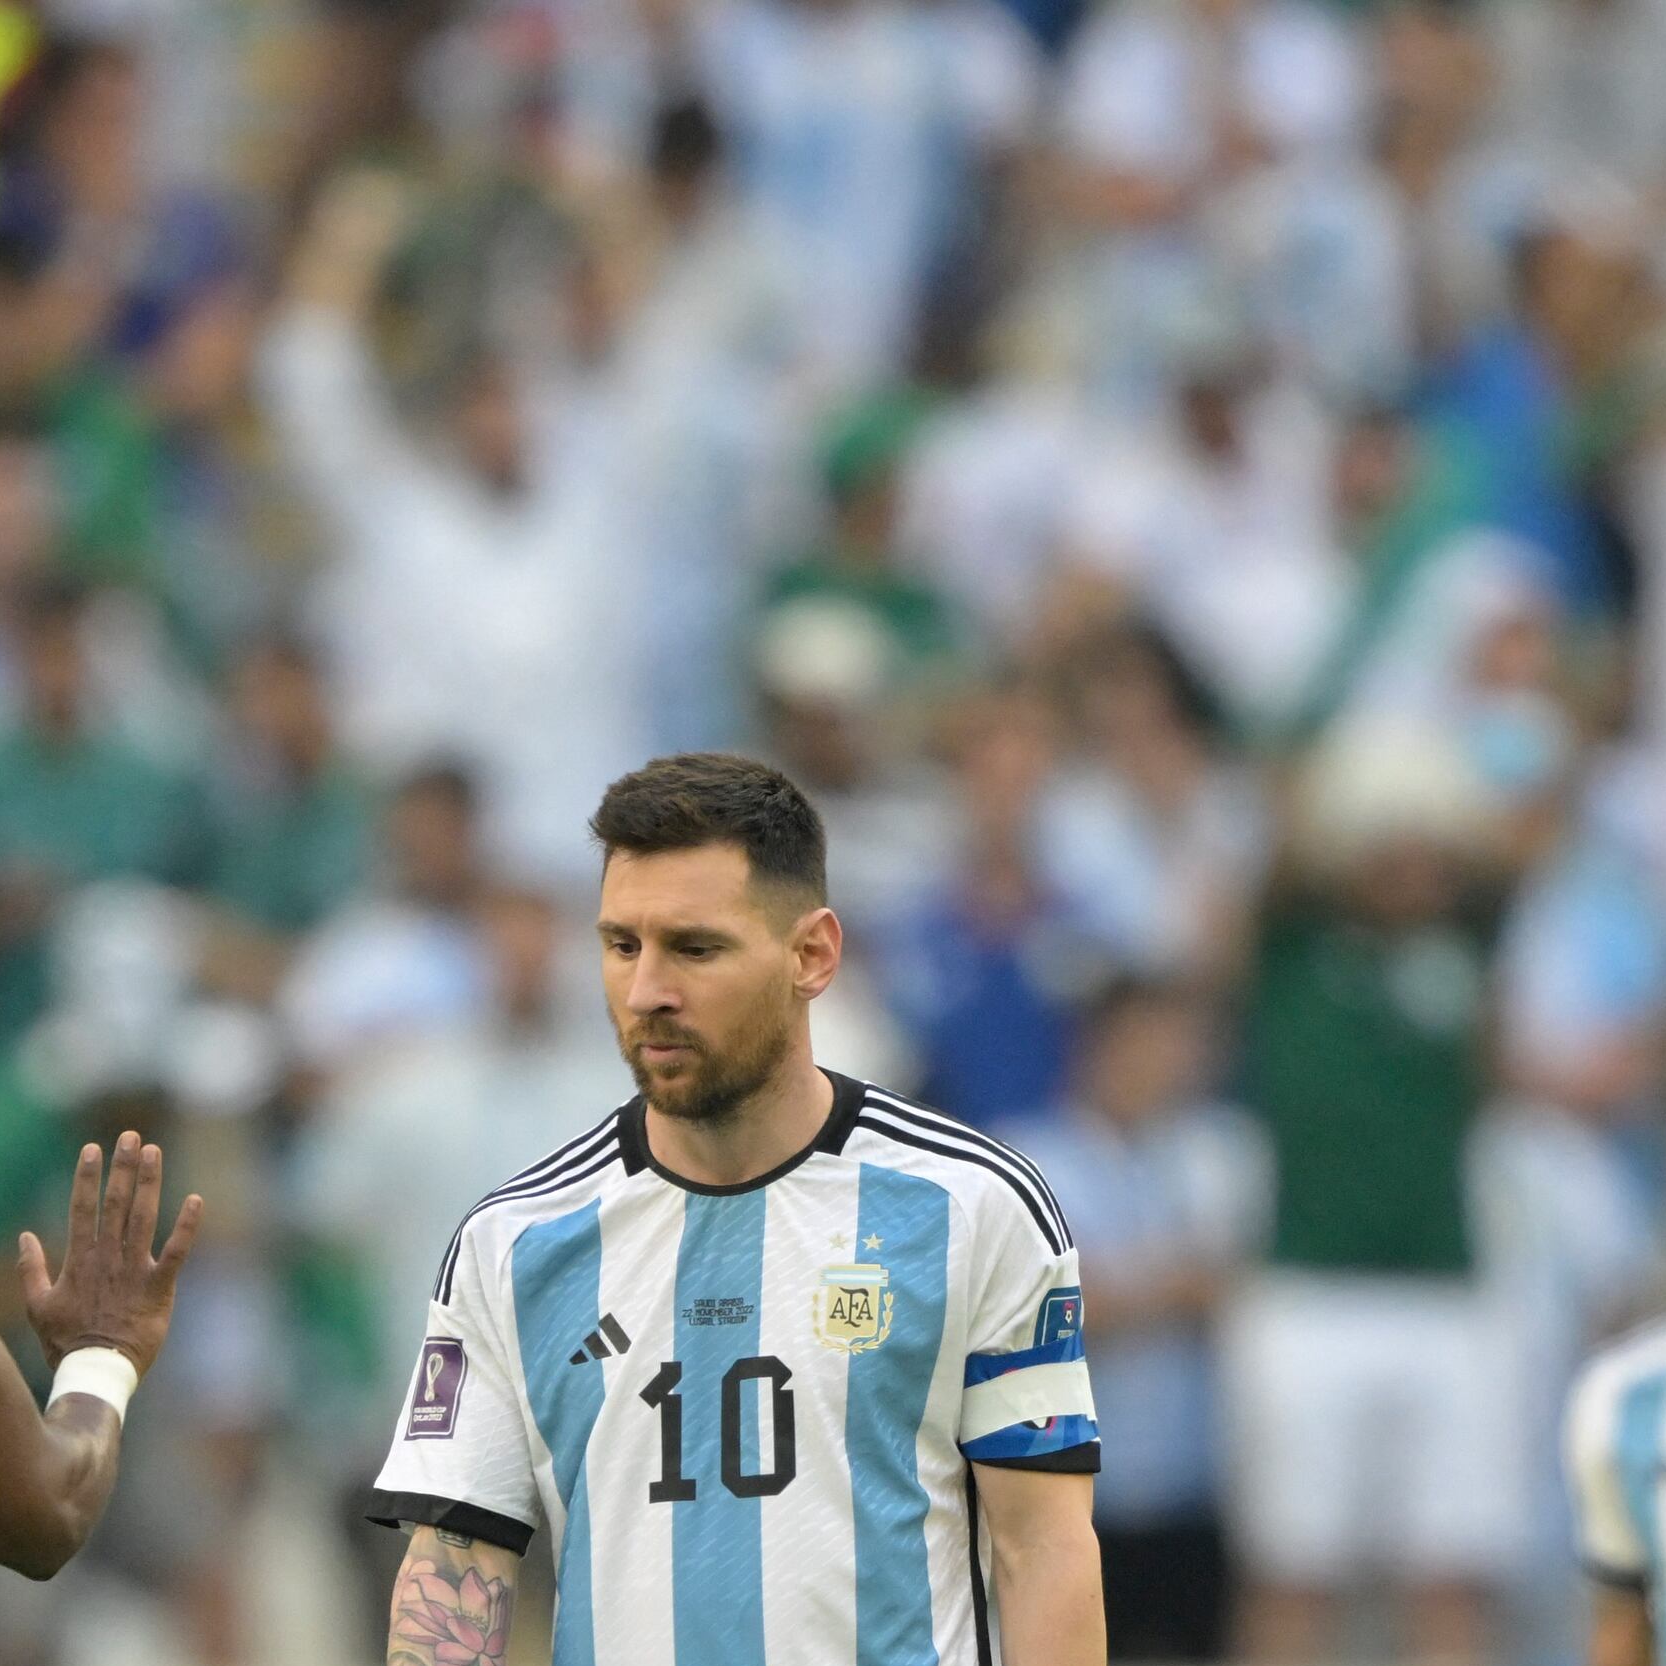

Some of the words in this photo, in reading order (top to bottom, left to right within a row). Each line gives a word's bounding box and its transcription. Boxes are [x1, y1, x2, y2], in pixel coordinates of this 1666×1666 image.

[682, 1309, 693, 1318] 22
[829, 1286, 874, 1328] AFA
[639, 1355, 797, 1504] 10
